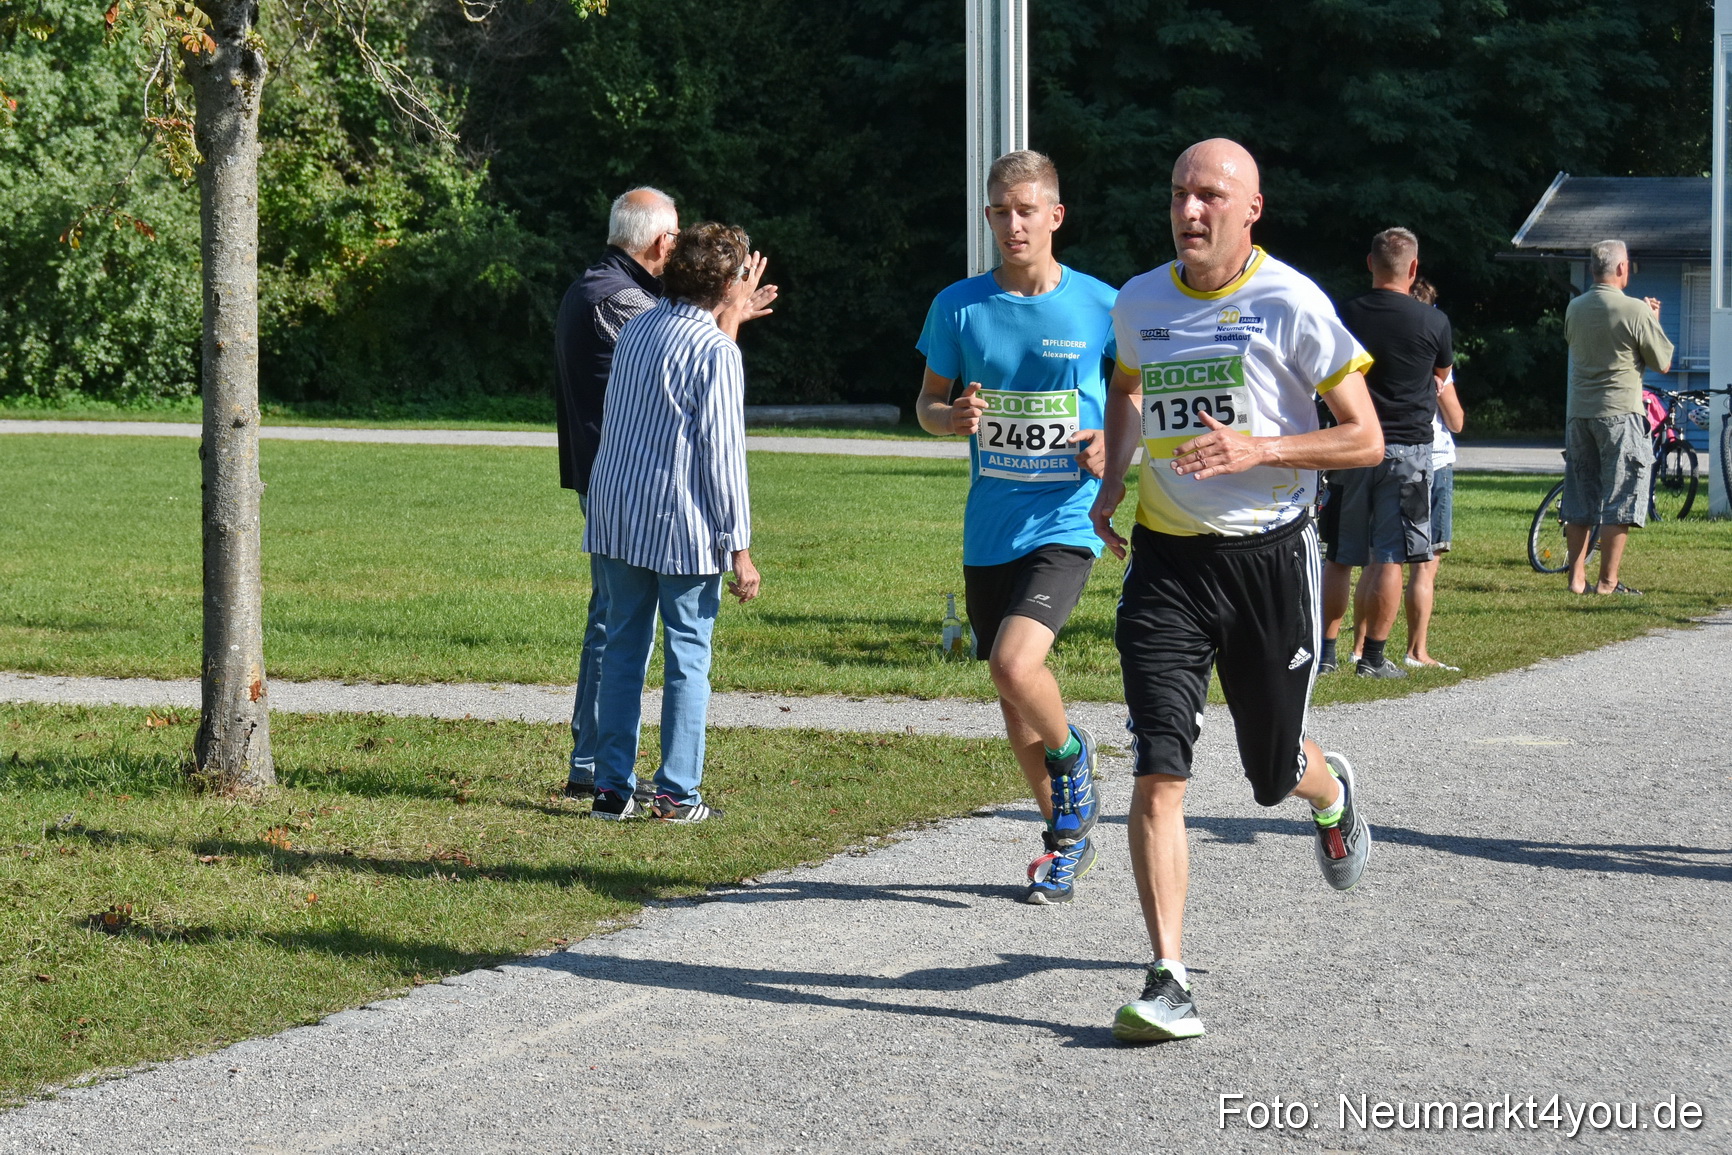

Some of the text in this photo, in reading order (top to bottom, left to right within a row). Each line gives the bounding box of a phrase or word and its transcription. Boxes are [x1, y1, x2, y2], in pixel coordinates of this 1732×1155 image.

[1219, 310, 1239, 323] 20
[1140, 329, 1170, 338] BOCK
[1216, 325, 1264, 334] Neumarkter
[1049, 339, 1087, 349] PFLEIDERER
[1214, 334, 1252, 342] Stadtlauf
[1042, 350, 1080, 360] Alexander
[1145, 362, 1233, 389] BOCK
[985, 395, 1069, 415] BOCK
[1150, 395, 1235, 431] 1395
[987, 421, 1066, 450] 2482
[988, 455, 1069, 470] ALEXANDER
